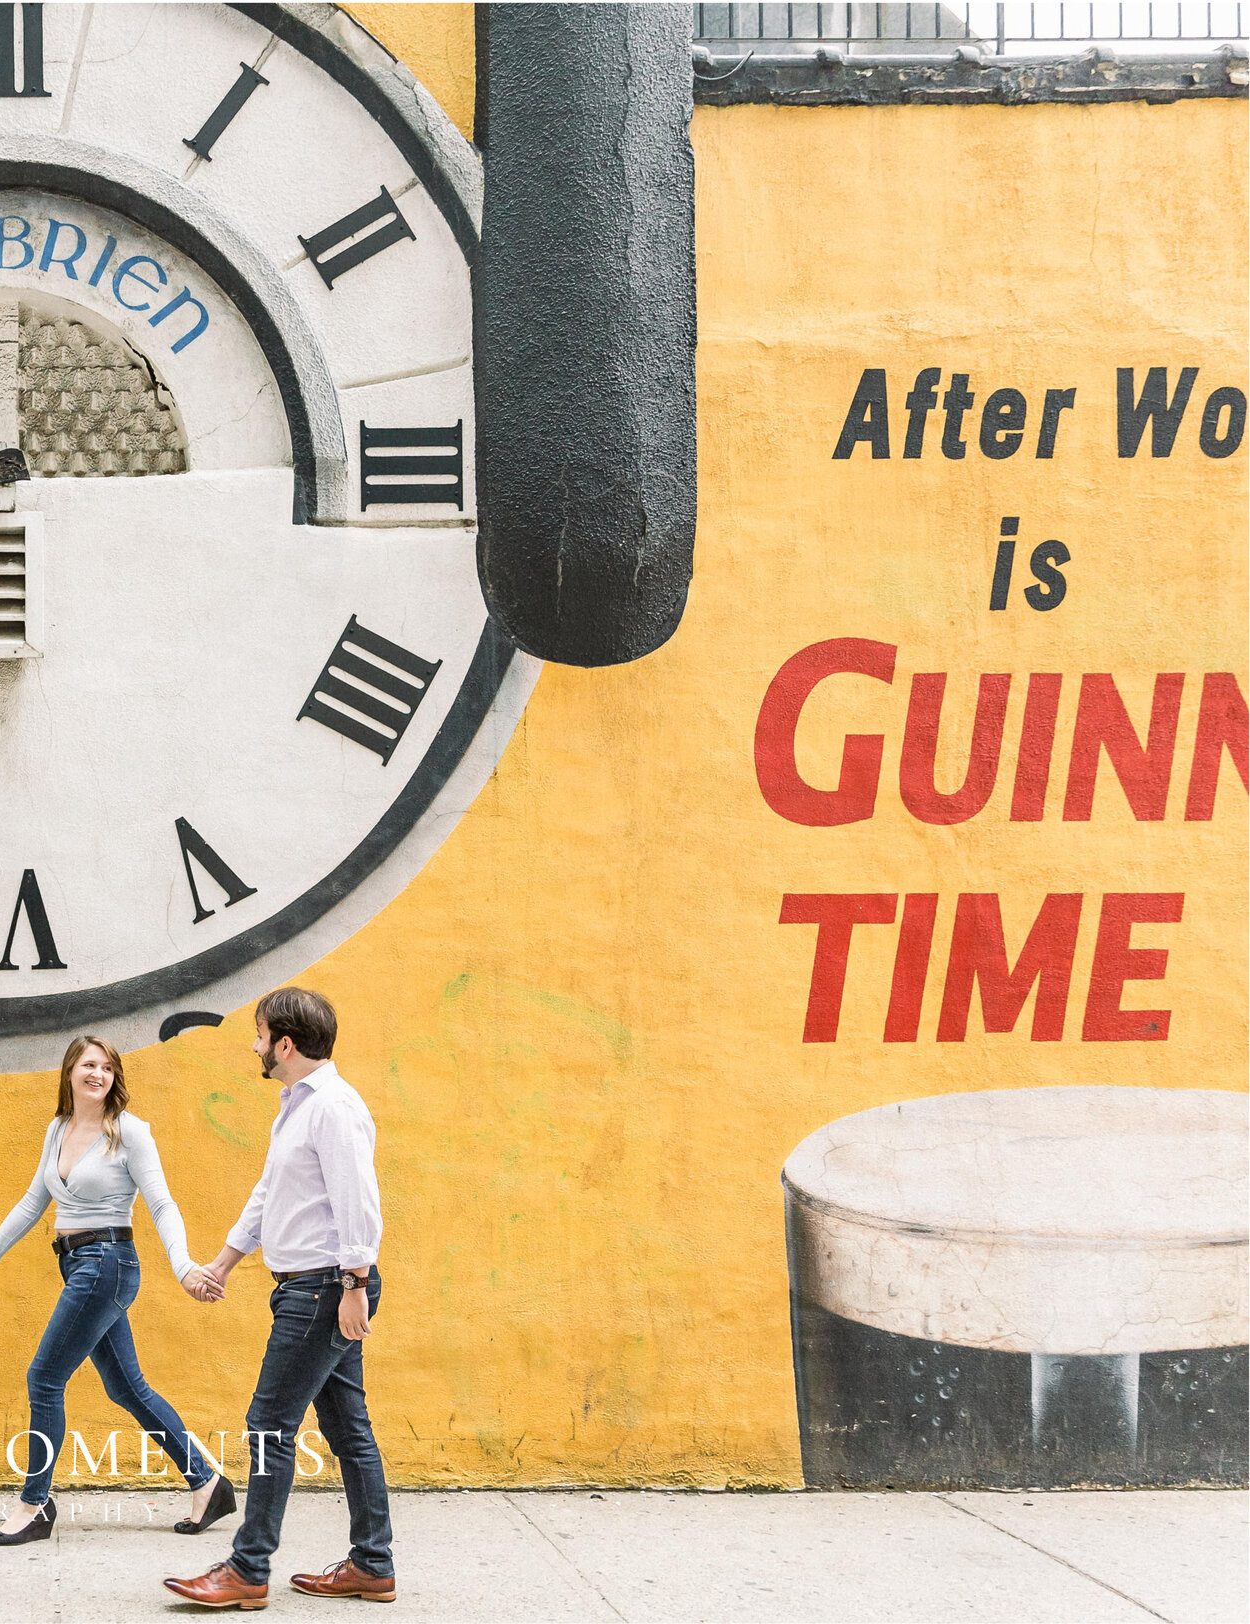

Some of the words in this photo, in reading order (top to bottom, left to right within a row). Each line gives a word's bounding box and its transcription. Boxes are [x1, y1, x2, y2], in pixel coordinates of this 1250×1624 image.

[298, 185, 416, 290] II
[833, 368, 1076, 459] After
[1117, 368, 1246, 458] Wo
[360, 419, 463, 512] III
[990, 517, 1070, 611] is
[780, 894, 1183, 1042] TIME
